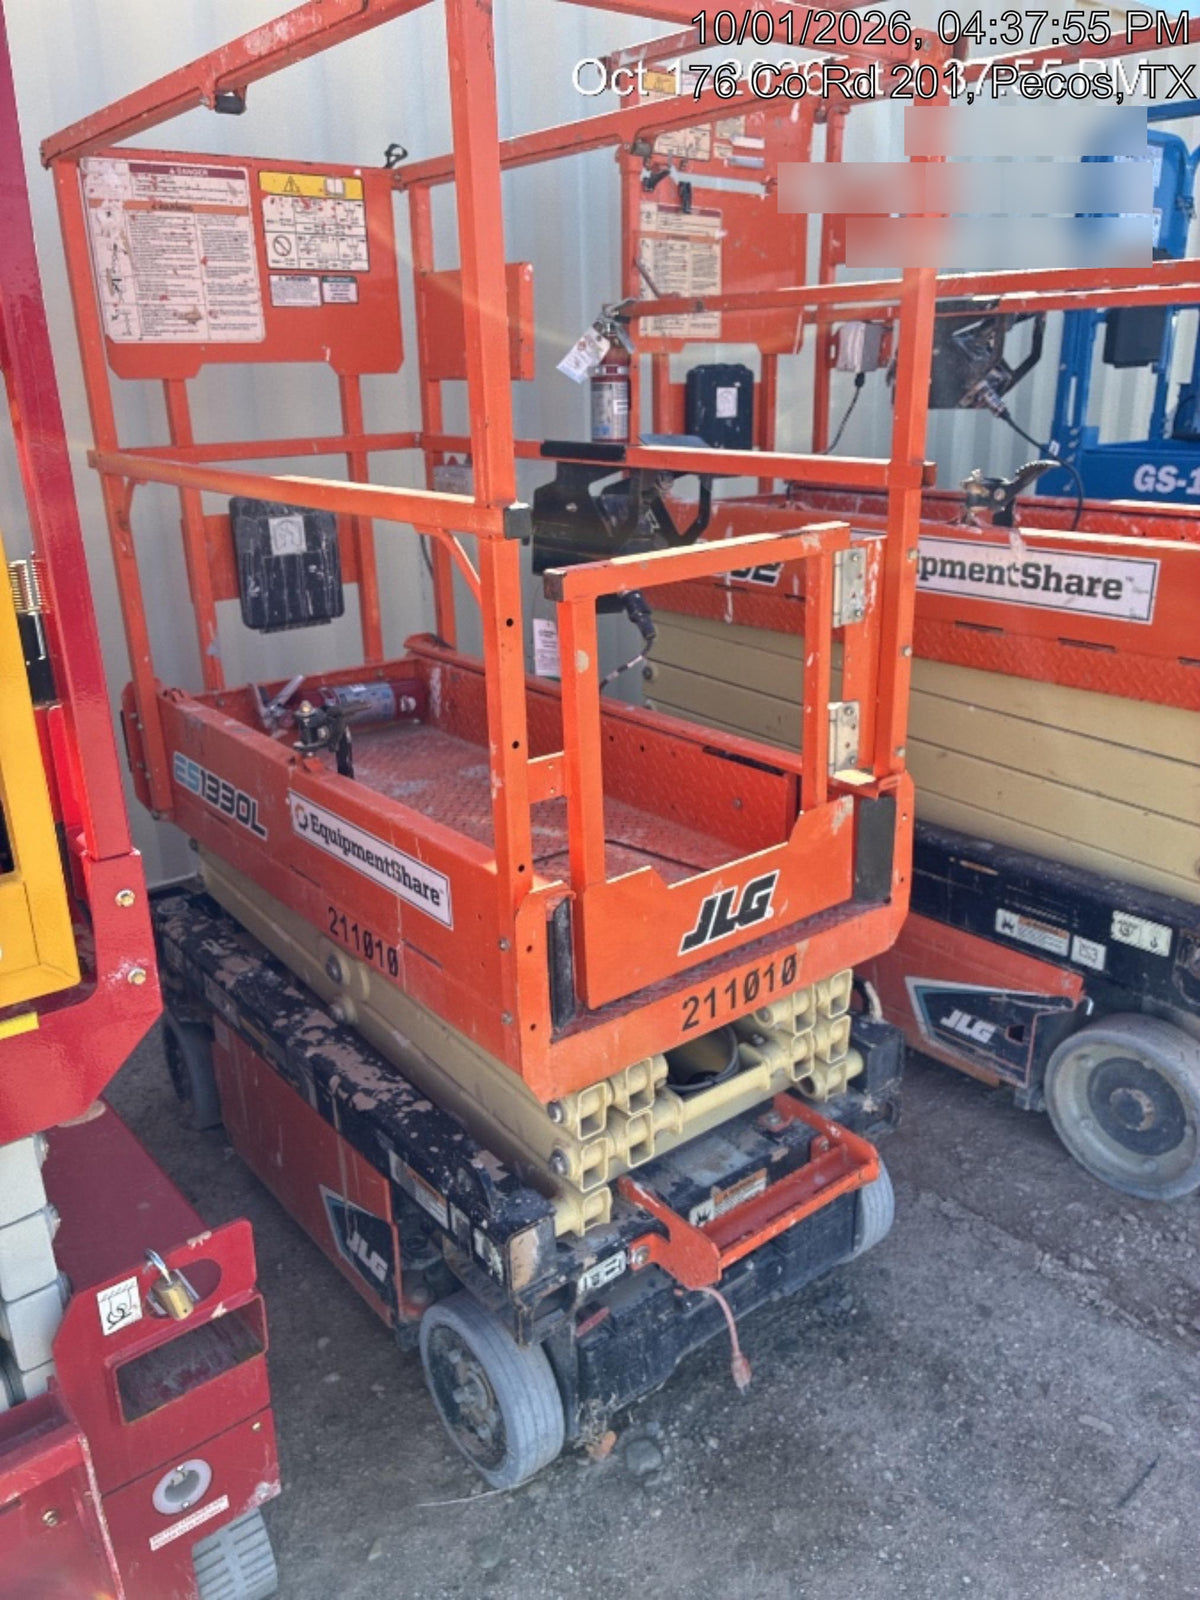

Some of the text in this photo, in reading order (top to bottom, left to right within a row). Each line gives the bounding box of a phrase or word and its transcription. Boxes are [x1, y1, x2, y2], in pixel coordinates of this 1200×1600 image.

[916, 554, 1123, 601] pmentShare
[174, 753, 267, 838] ES1330L
[309, 813, 441, 907] EquipmentShare
[327, 905, 399, 978] 211010
[678, 870, 781, 956] JLG
[681, 952, 798, 1032] 211010
[940, 1008, 997, 1044] JLG
[346, 1230, 389, 1283] JLG
